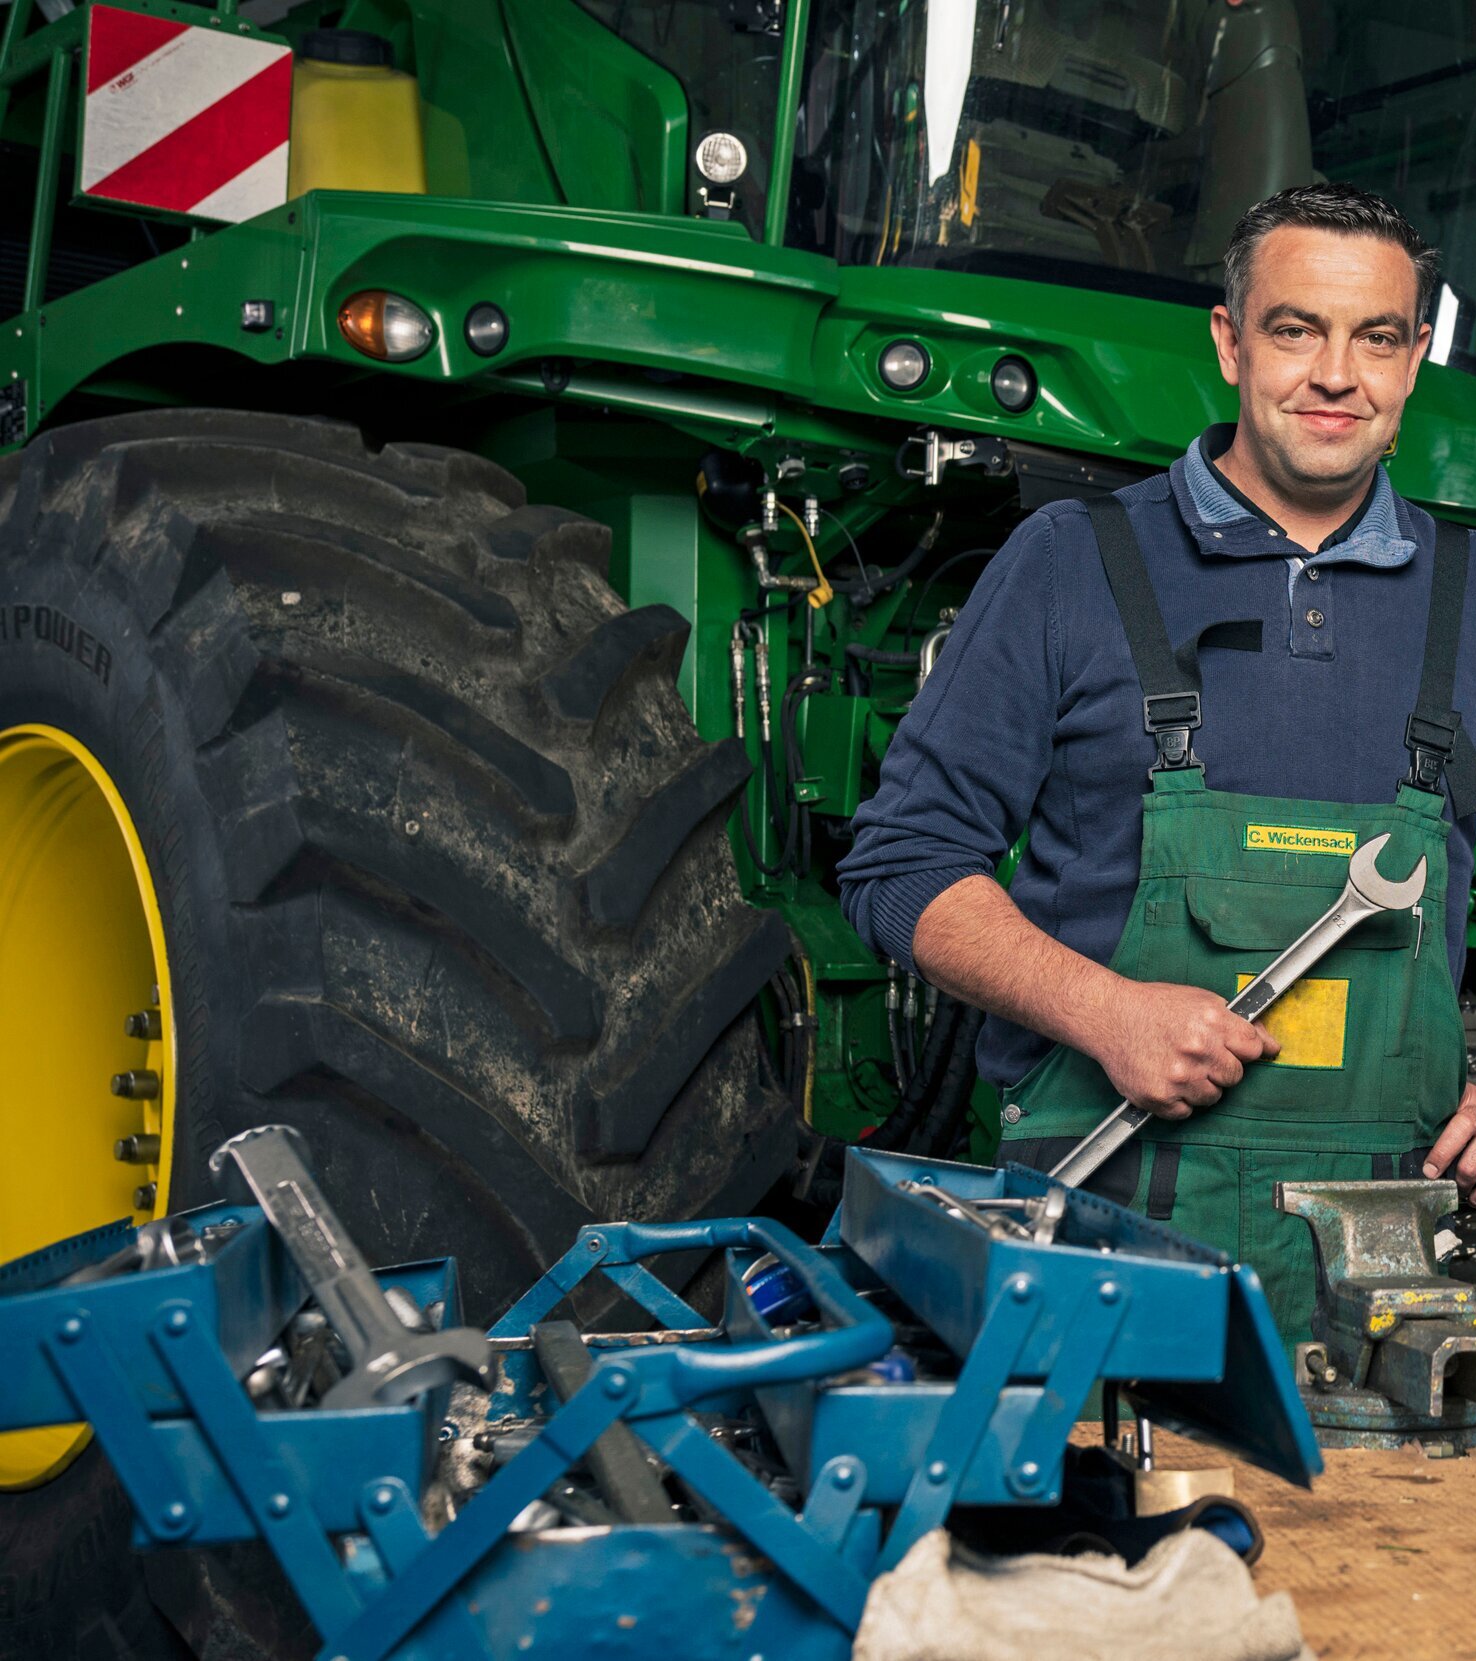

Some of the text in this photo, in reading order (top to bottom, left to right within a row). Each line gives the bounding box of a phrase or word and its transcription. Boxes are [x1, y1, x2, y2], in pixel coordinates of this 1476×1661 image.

[14, 604, 112, 688] POWER
[1248, 830, 1354, 850] C. Wickensack
